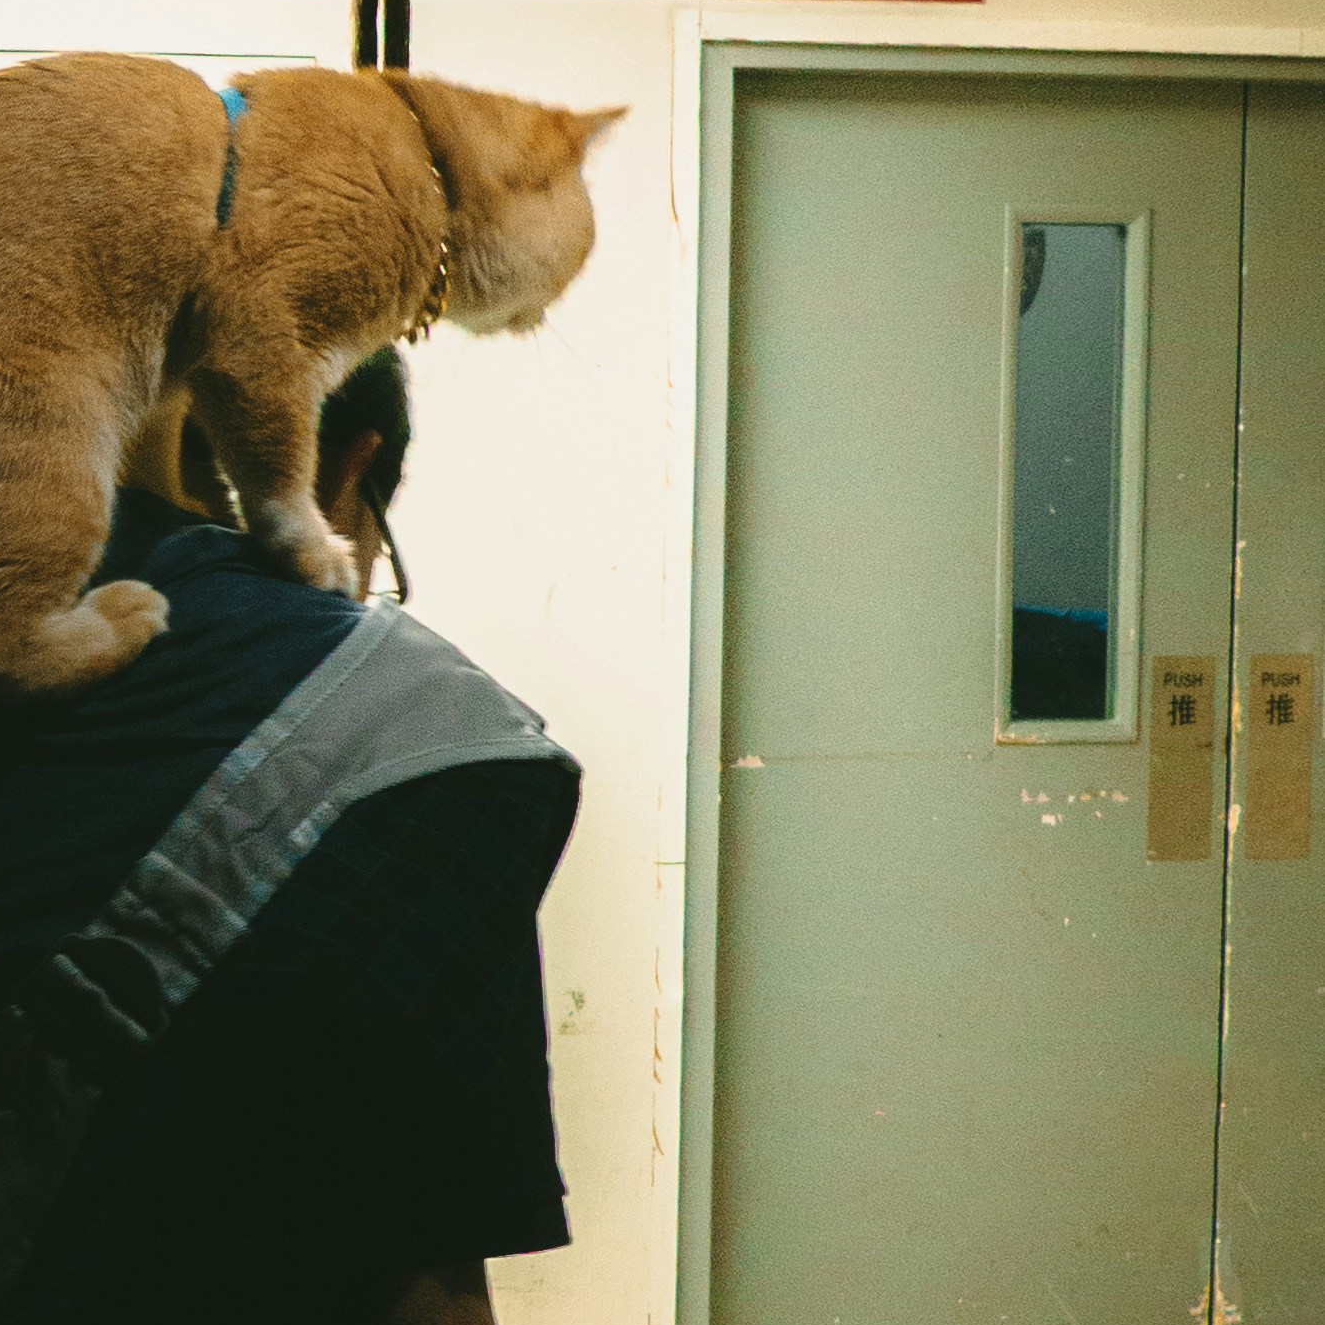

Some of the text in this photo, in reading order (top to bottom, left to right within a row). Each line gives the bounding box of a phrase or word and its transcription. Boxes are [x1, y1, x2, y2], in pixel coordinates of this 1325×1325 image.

[1163, 672, 1204, 688] PUSH
[1261, 672, 1301, 688] PUSH
[1168, 695, 1197, 726] 推
[1266, 693, 1295, 726] 推
